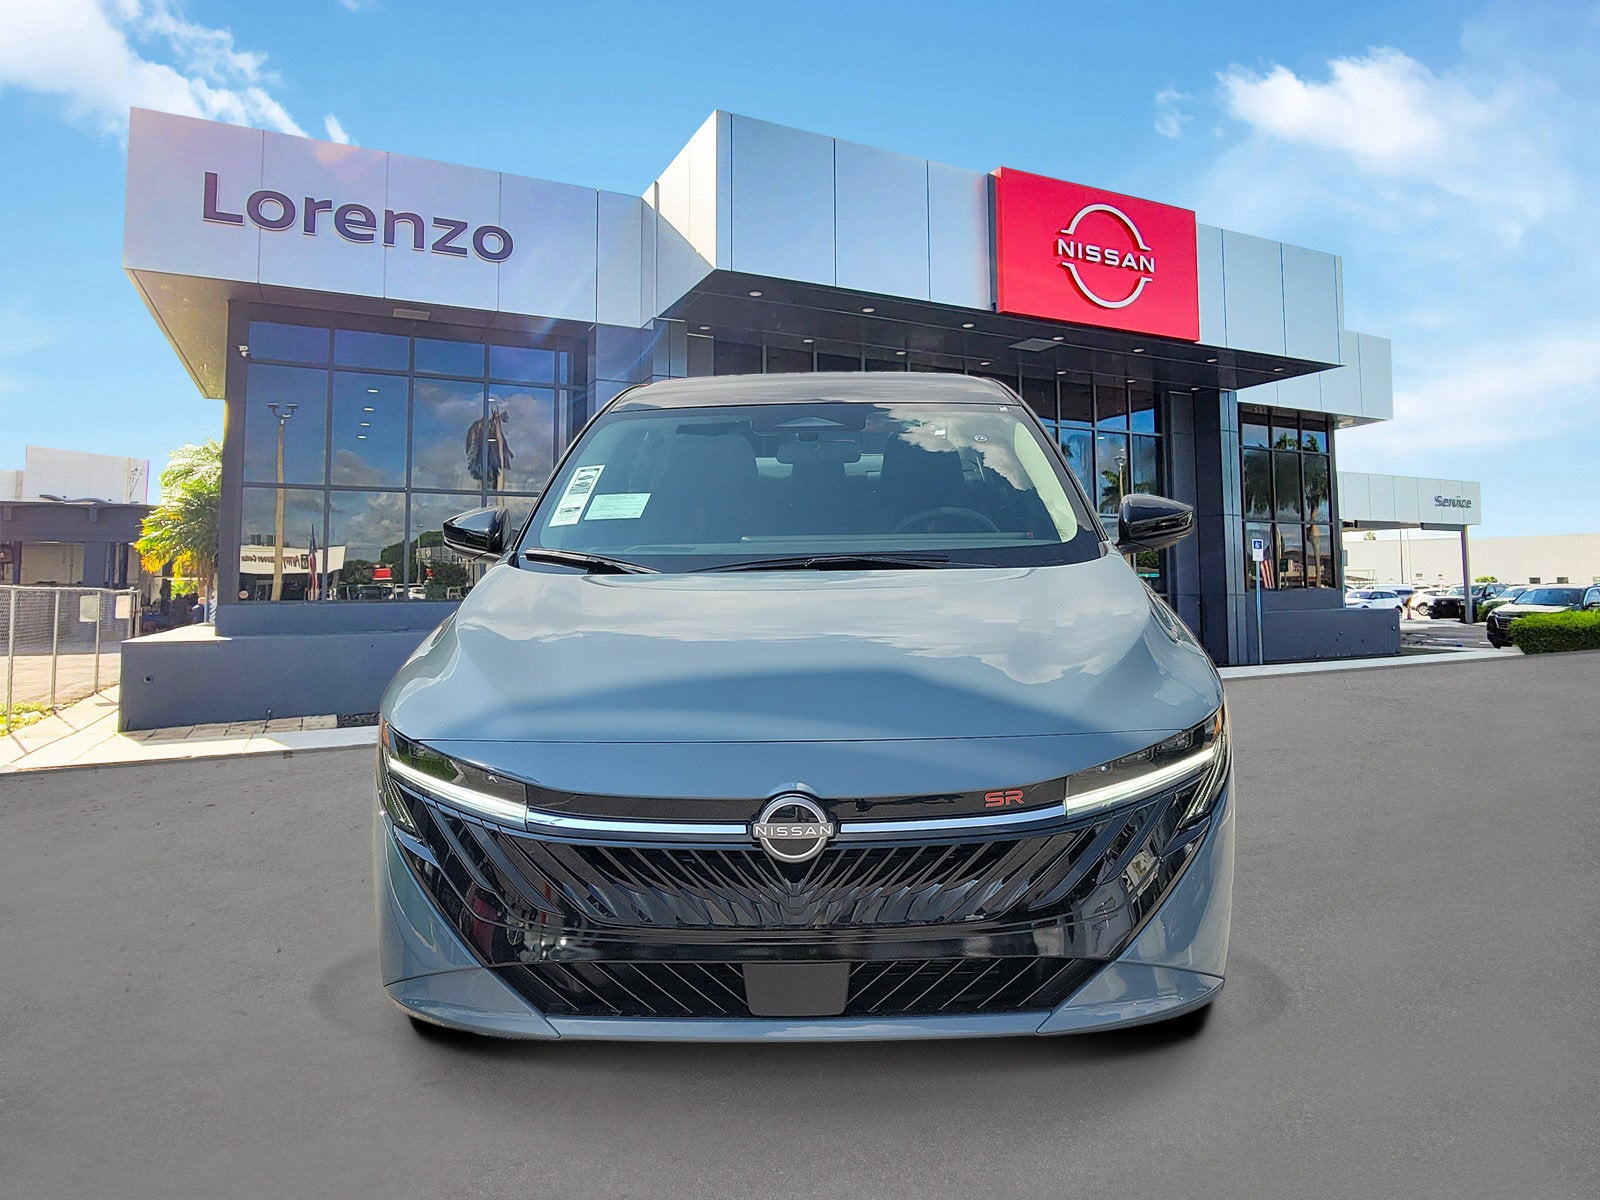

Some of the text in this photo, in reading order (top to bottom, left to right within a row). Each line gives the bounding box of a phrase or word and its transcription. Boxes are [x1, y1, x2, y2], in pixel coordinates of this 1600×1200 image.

[202, 171, 514, 263] Lorenzo
[1057, 238, 1155, 273] NISSAN
[1434, 495, 1472, 508] Service
[984, 790, 1024, 808] SR
[754, 824, 834, 838] NISSAN
